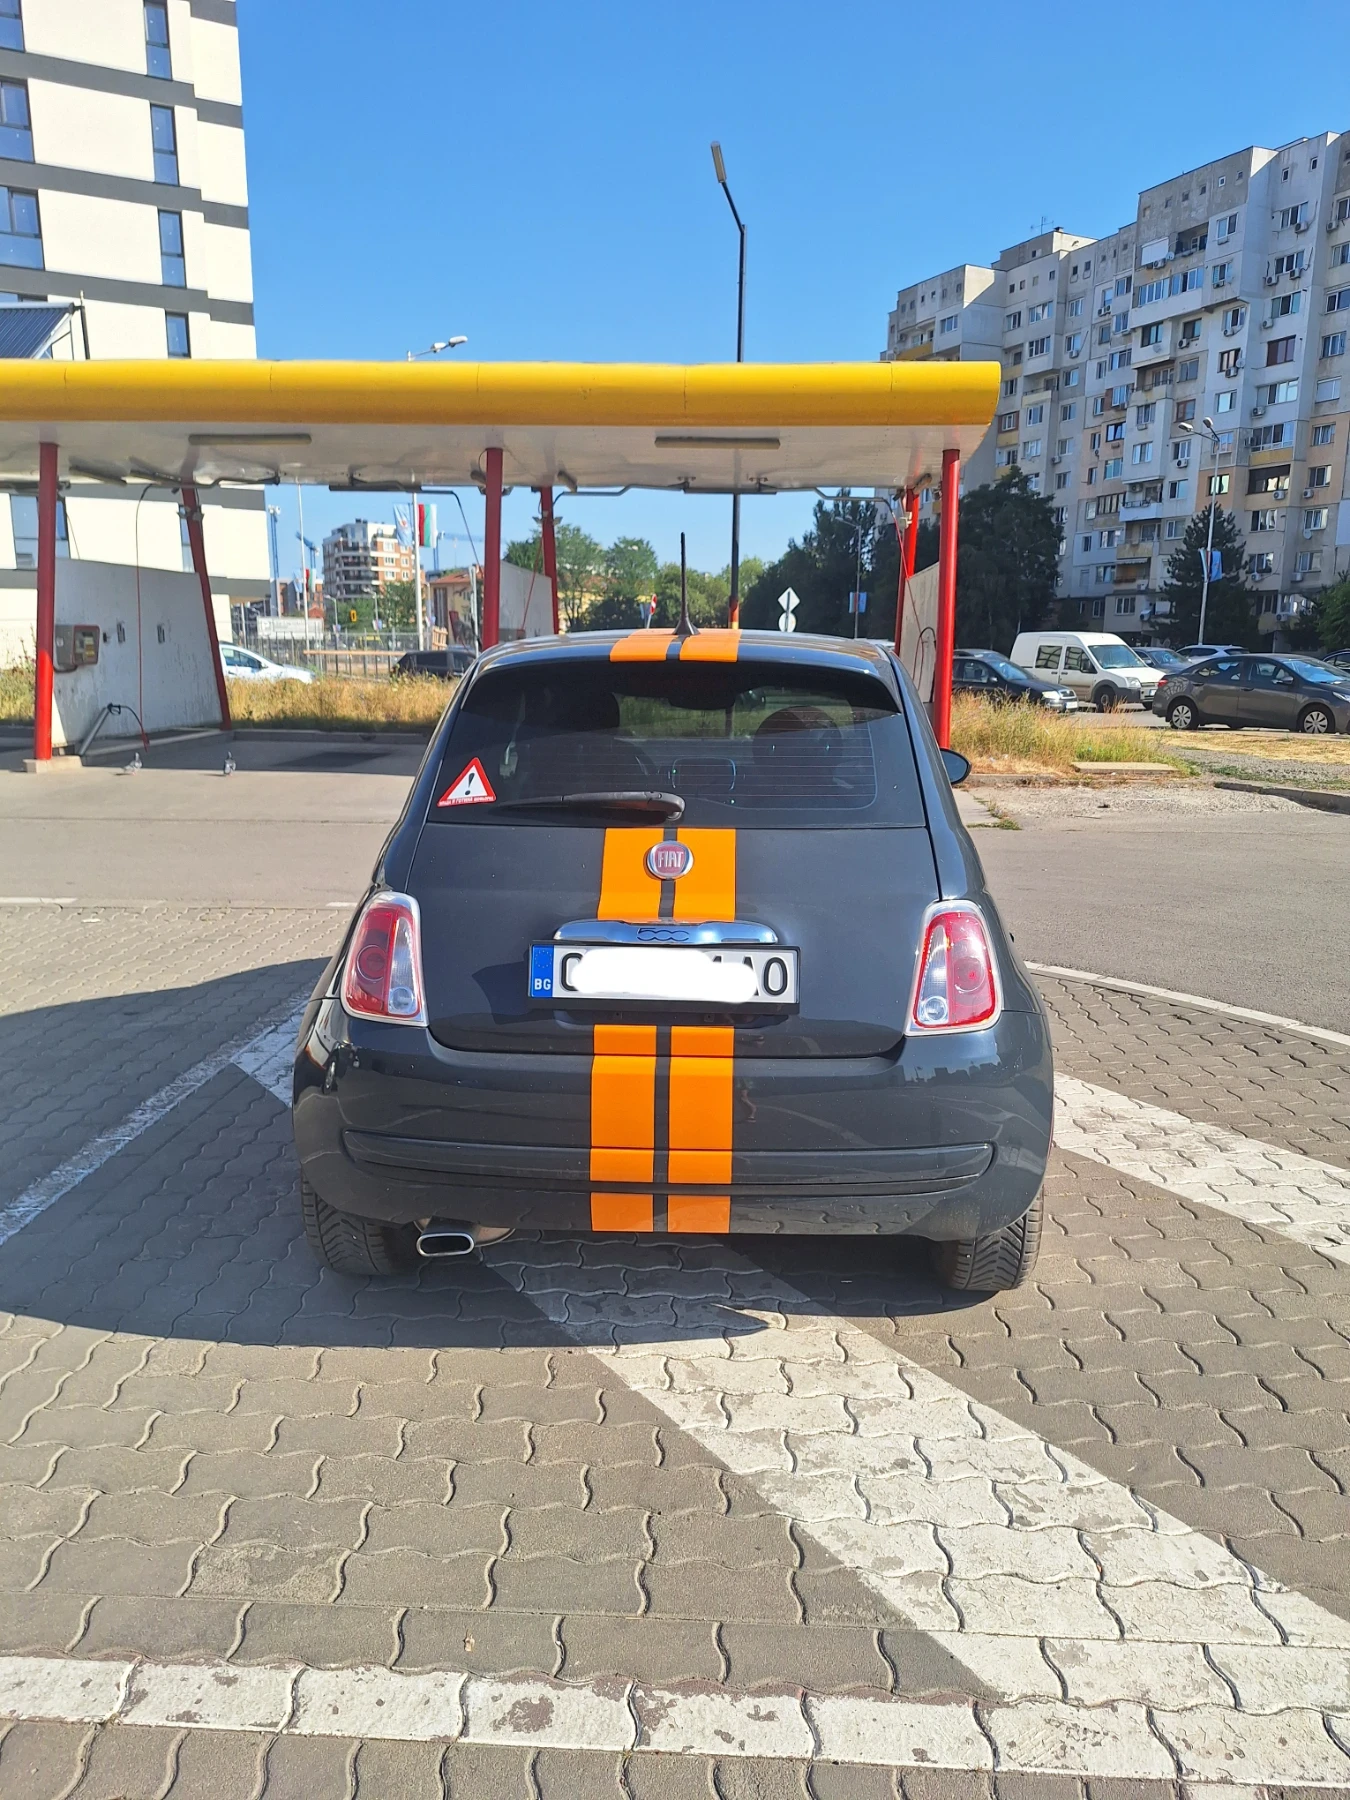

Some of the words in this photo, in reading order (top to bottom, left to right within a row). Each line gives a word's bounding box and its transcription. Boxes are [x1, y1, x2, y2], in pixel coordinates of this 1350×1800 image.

[657, 851, 684, 868] FIAT
[637, 927, 690, 942] 500
[534, 978, 552, 991] BG
